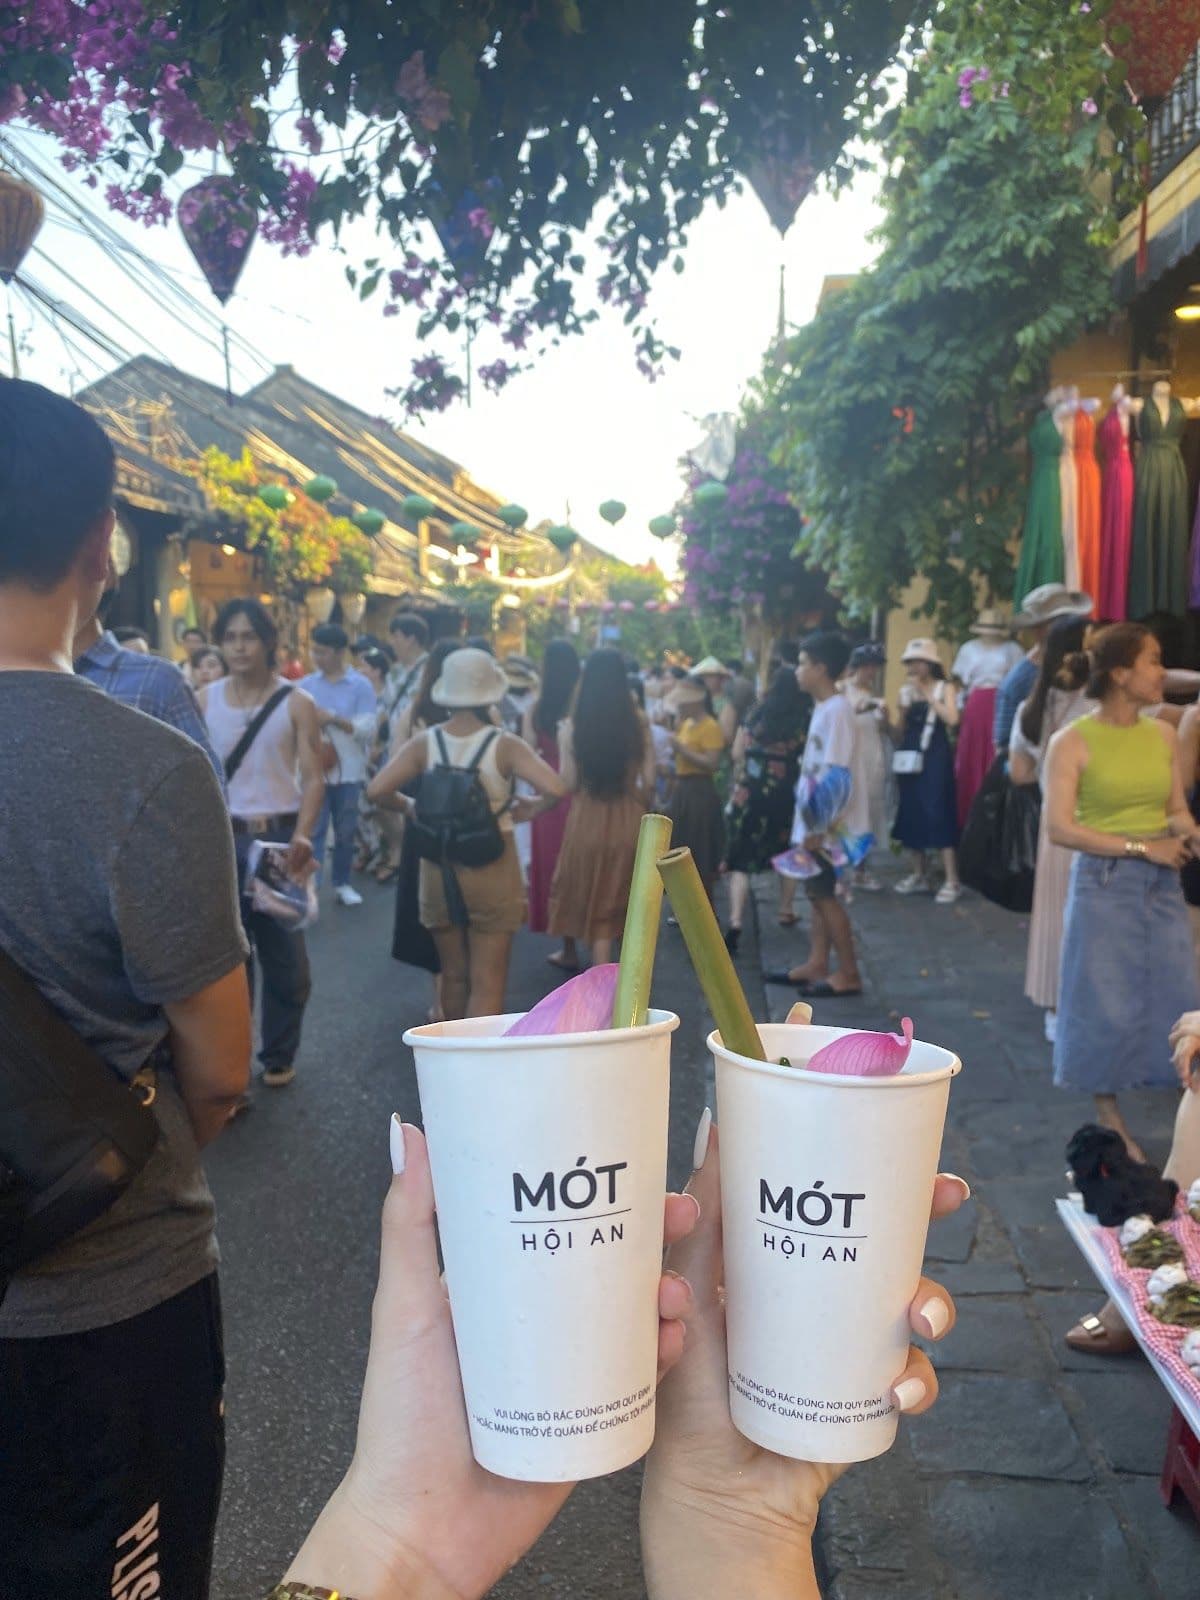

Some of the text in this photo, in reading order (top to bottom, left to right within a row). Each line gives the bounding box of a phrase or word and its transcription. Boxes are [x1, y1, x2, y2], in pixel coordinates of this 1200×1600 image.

[512, 1156, 627, 1212] MÓT
[760, 1178, 866, 1228] MÓT
[522, 1223, 623, 1255] HỘI AN
[763, 1232, 857, 1262] HỘI AN
[493, 1407, 508, 1419] VUI
[553, 1410, 573, 1421] RÁC
[575, 1405, 604, 1419] ĐÚNG
[605, 1399, 621, 1413] NƠI
[778, 1392, 795, 1404] RÁC
[797, 1397, 825, 1409] ĐÚNG
[844, 1400, 862, 1411] QUY
[778, 1407, 804, 1420] QUÁN
[820, 1413, 851, 1424] CHÚNG
[852, 1412, 865, 1423] TÔI
[494, 1422, 519, 1436] MANG
[554, 1424, 583, 1437] QUÁN
[600, 1412, 629, 1430] CHÚNG
[111, 1501, 160, 1600] PLIS
